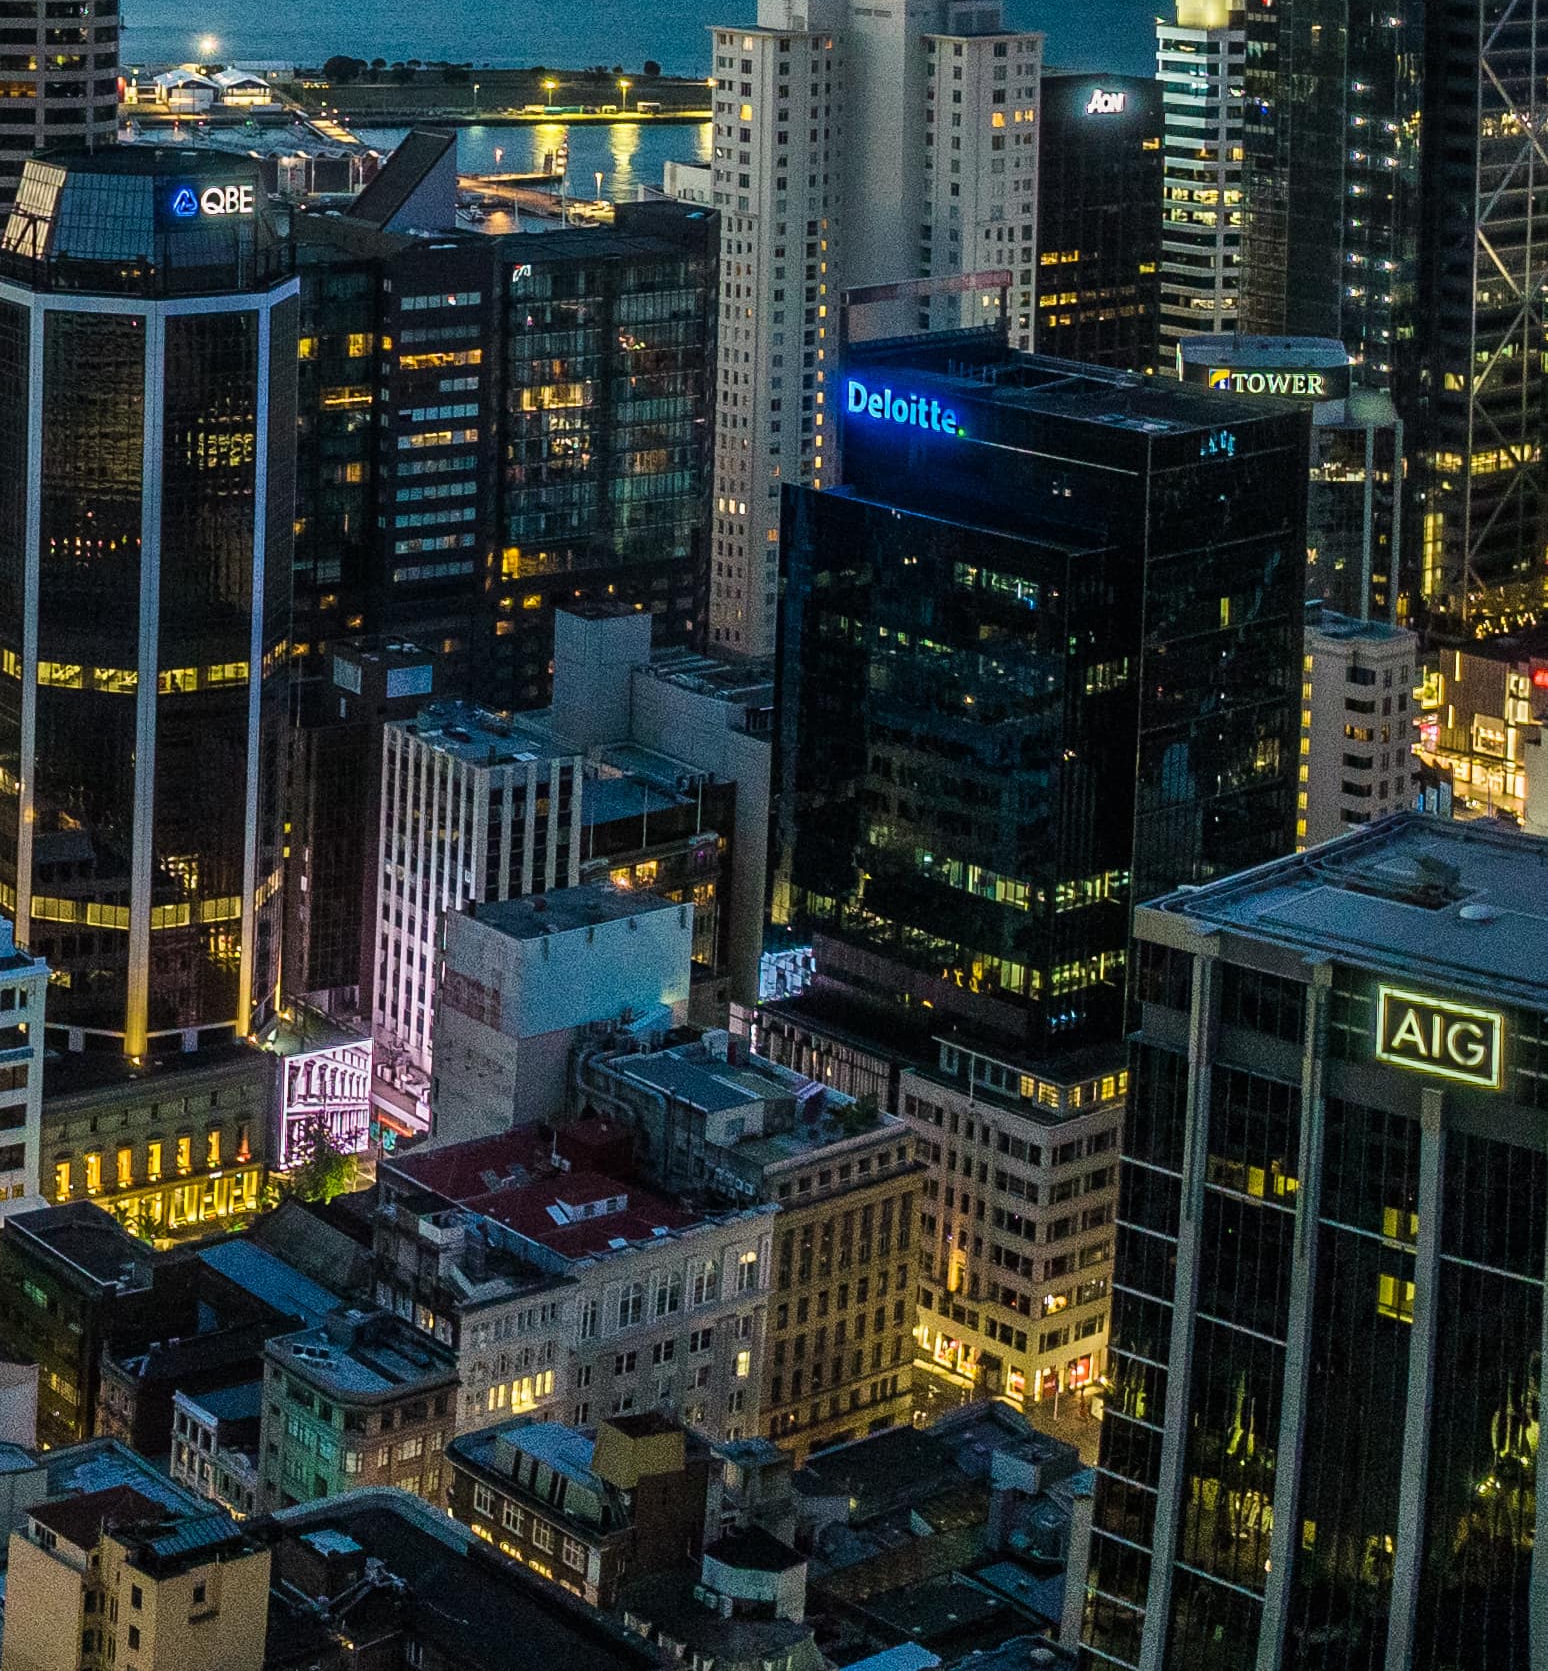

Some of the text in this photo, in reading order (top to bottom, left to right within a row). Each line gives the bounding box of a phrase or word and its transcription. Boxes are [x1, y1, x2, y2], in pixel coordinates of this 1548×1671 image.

[200, 186, 254, 215] QBE
[1231, 373, 1326, 394] TOWER
[1390, 1007, 1487, 1067] AIG
